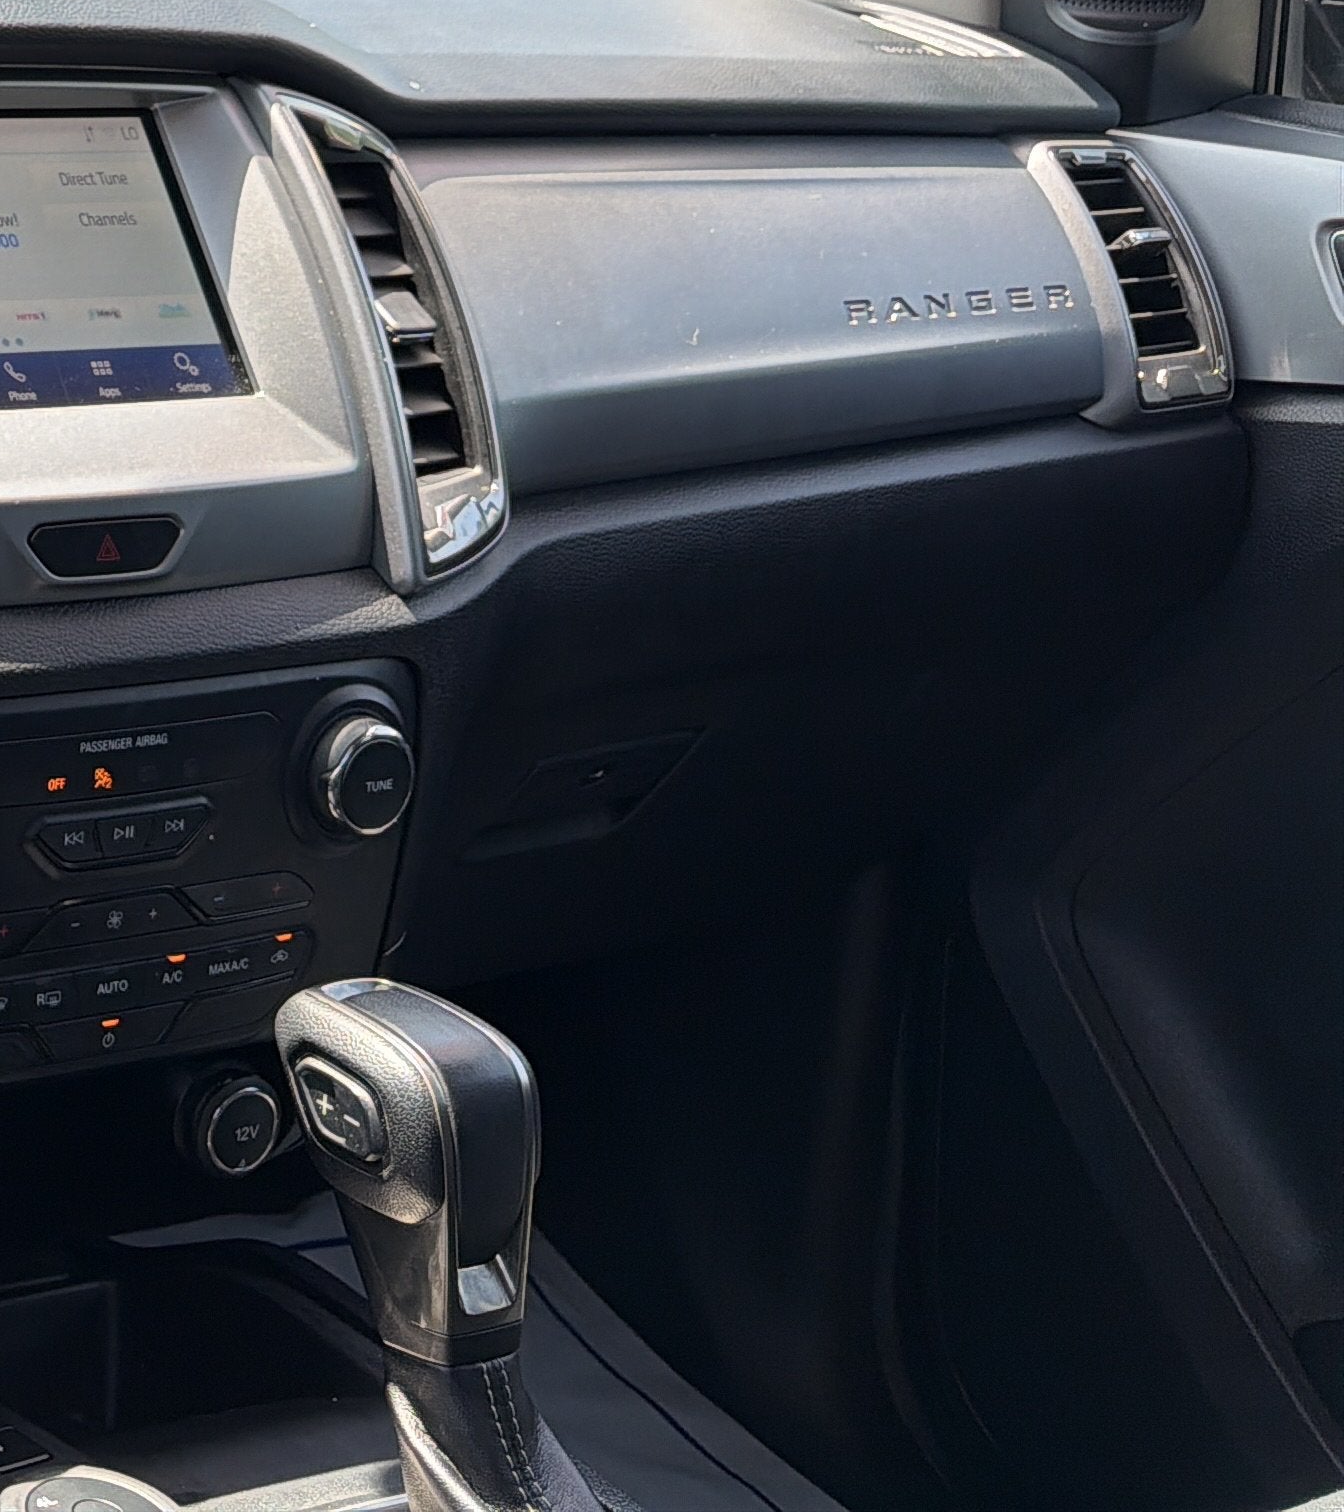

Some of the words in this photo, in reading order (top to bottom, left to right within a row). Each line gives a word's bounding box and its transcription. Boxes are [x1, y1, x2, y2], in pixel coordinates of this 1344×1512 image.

[120, 126, 140, 141] LO
[58, 172, 95, 187] Direct
[97, 171, 128, 186] Tune
[78, 211, 138, 228] Channels
[843, 284, 1075, 327] RANGER
[8, 390, 37, 401] Phone
[98, 386, 121, 398] Apps
[176, 381, 211, 394] Settings
[79, 737, 133, 753] PASSENGER
[135, 733, 169, 748] AIRBAG
[47, 777, 67, 791] OFF
[365, 778, 394, 793] TUNE
[162, 969, 183, 985] A/C
[96, 978, 129, 995] AUTO
[235, 1123, 261, 1144] 12V
